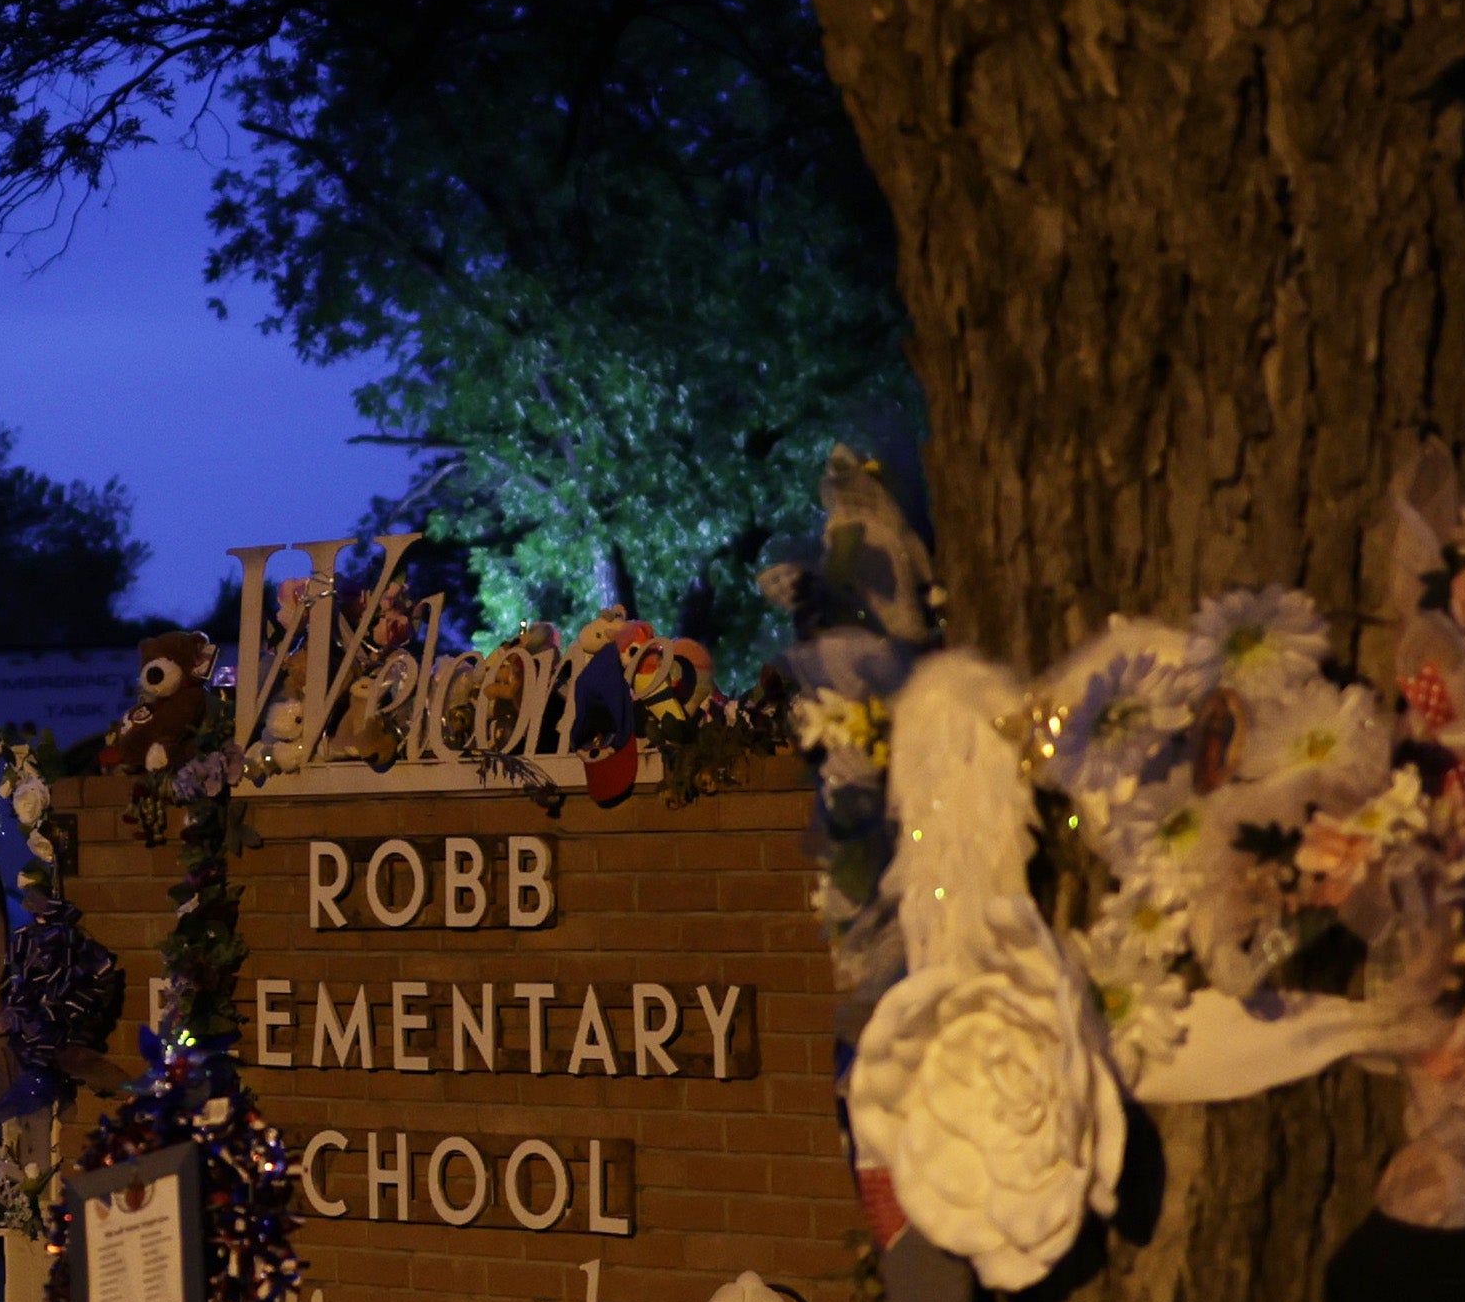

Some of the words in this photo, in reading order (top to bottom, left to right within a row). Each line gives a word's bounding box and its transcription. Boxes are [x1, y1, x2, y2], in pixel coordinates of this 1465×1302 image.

[47, 702, 105, 719] TASK
[309, 834, 556, 929] ROBB
[149, 977, 743, 1080] EMENTARY
[302, 1129, 630, 1236] CHOOL
